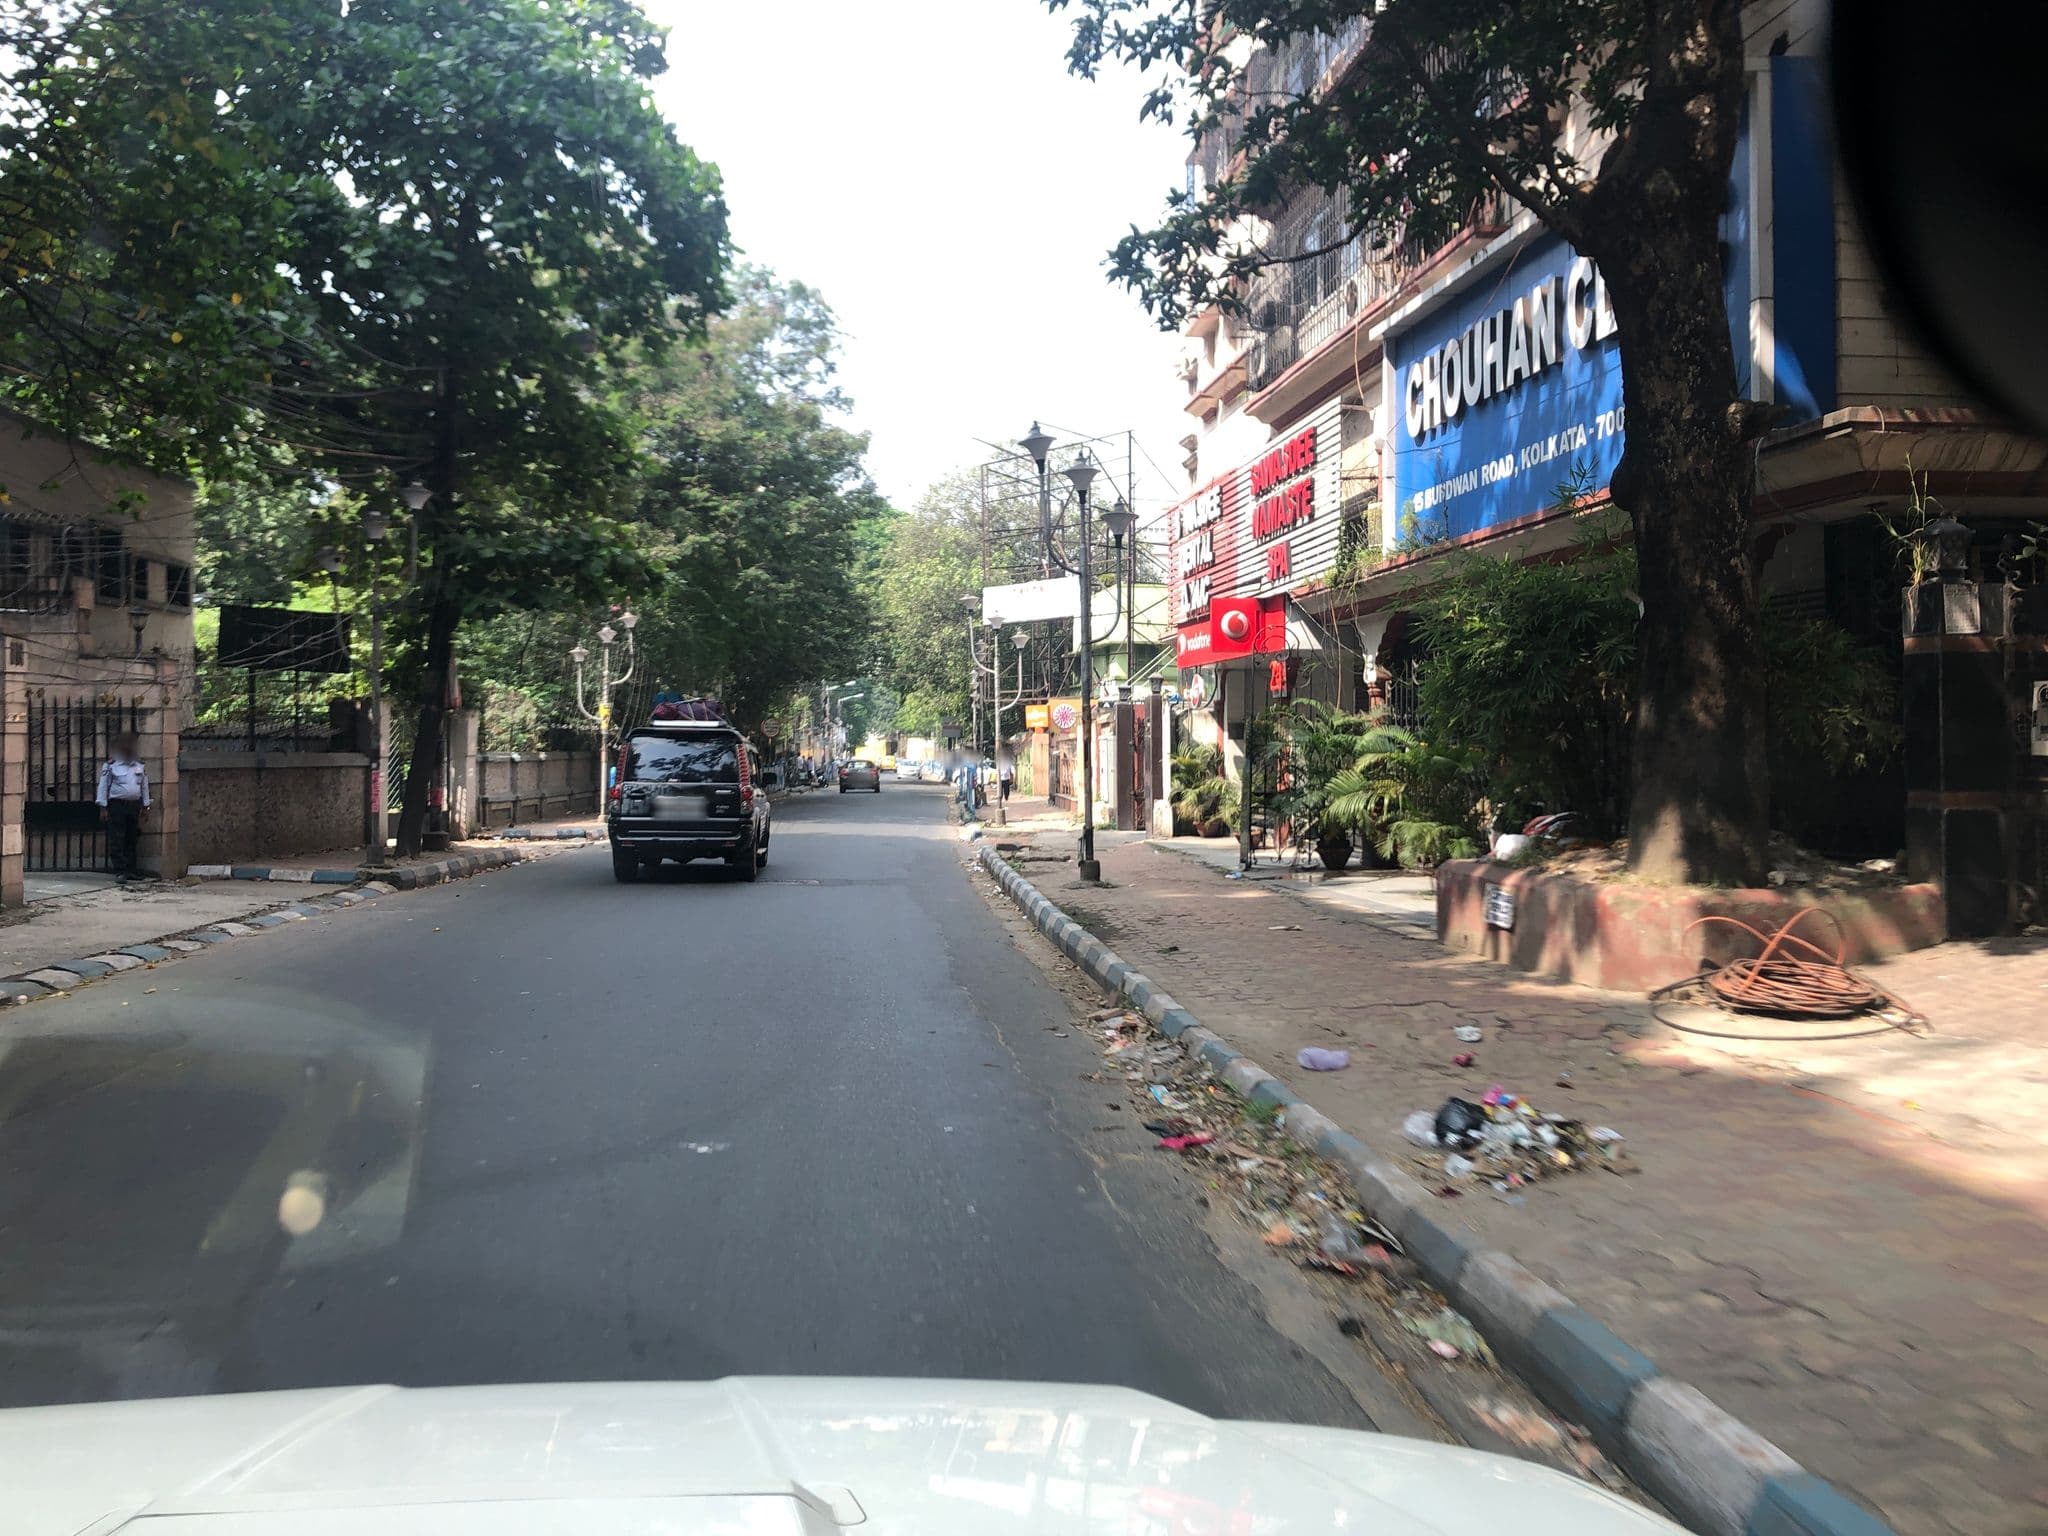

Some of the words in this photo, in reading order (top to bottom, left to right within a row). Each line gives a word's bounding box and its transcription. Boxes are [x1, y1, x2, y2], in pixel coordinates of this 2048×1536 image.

[1404, 276, 1556, 438] CHOUHAN
[1481, 453, 1518, 486] ROAD,
[1521, 426, 1587, 470] KOLKATA
[1266, 540, 1289, 582] SPA
